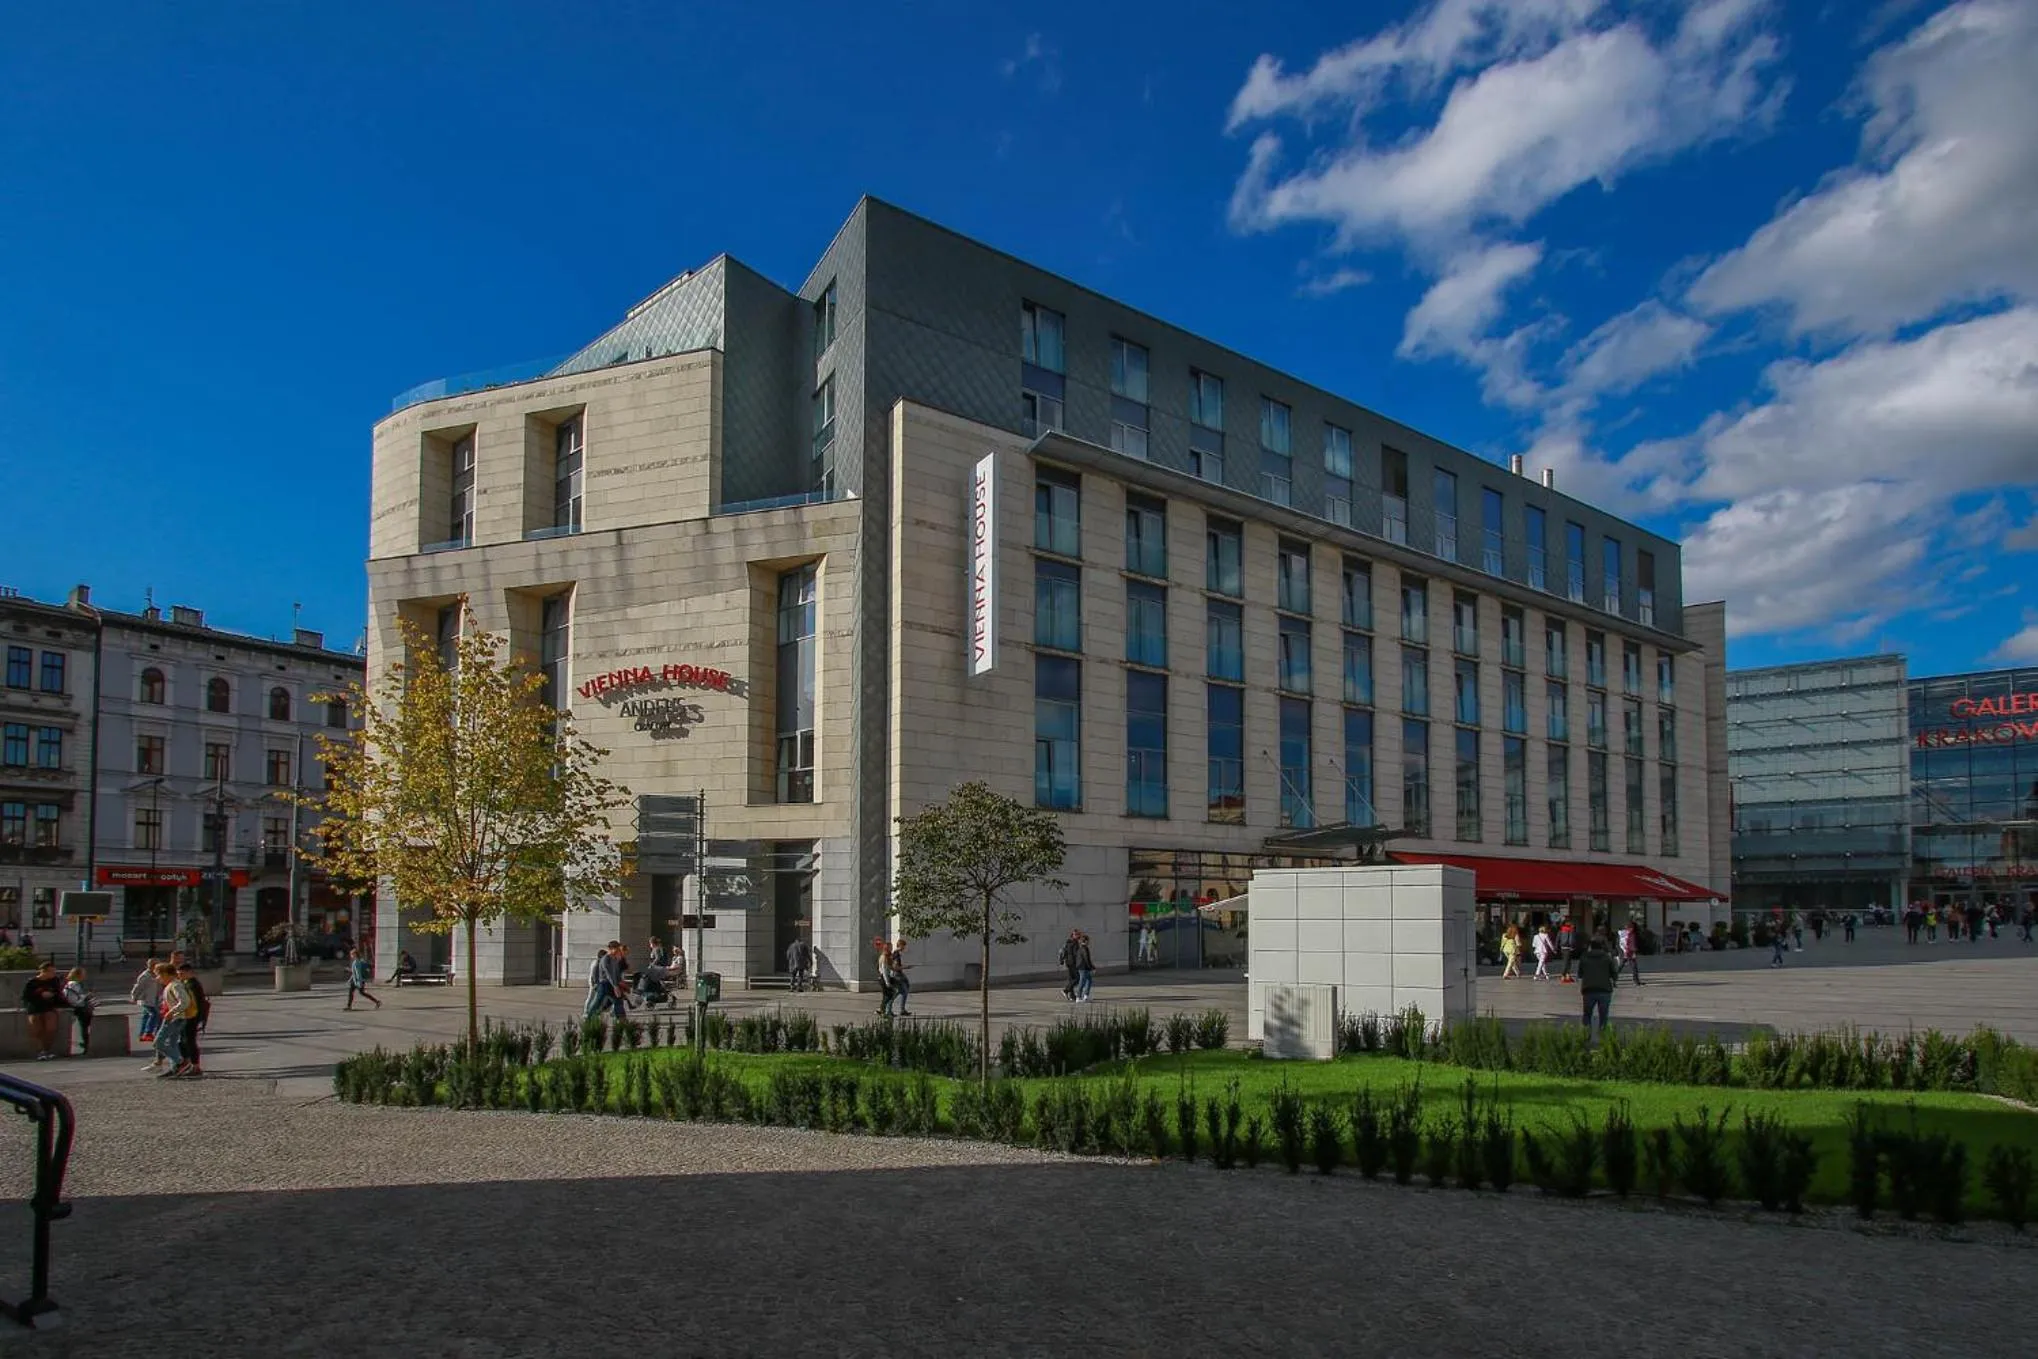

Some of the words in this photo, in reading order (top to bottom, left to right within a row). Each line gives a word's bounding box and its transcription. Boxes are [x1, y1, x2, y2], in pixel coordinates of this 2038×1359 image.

[975, 469, 986, 561] HOUSE
[975, 563, 986, 663] VIENNA
[576, 666, 652, 698] VIENNA
[662, 664, 731, 692] HOUSE
